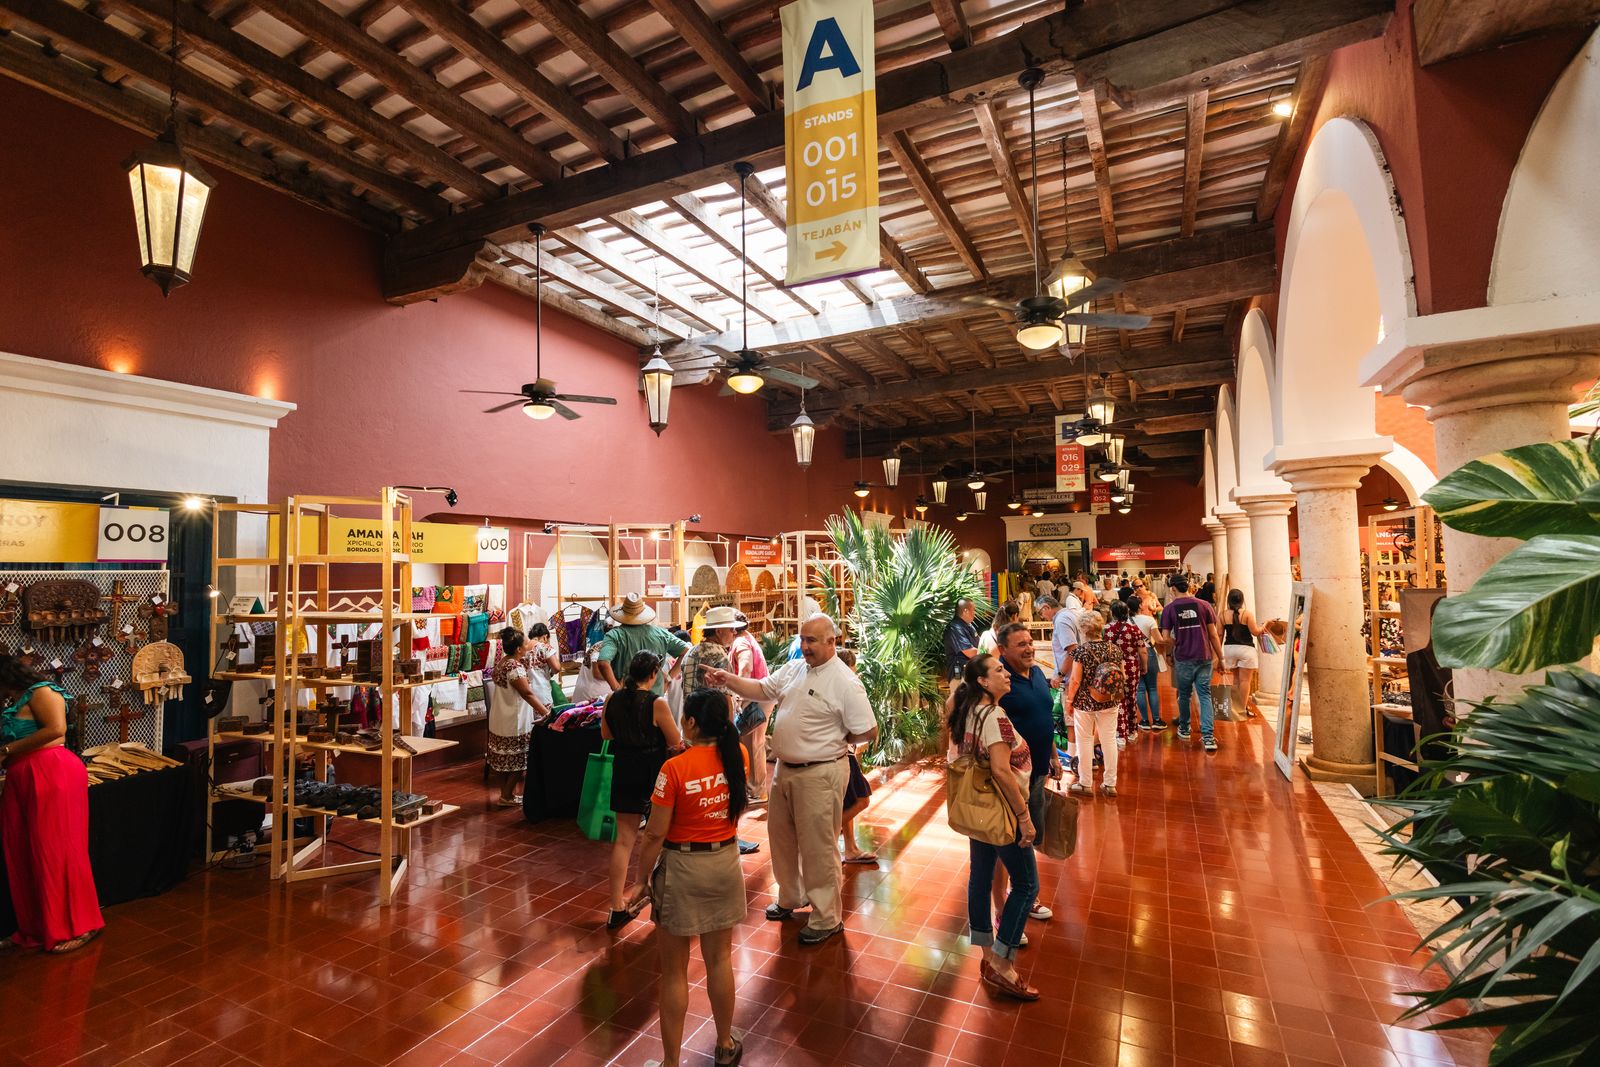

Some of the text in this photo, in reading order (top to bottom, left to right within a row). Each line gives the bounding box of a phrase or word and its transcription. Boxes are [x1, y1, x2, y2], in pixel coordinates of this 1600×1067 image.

[796, 17, 861, 92] A
[804, 108, 854, 128] STANDS
[803, 132, 857, 167] 001
[806, 173, 857, 207] 015
[802, 219, 862, 240] TEJABÁN
[1062, 453, 1079, 461] 016
[1061, 464, 1080, 472] 029
[104, 523, 165, 543] 008
[347, 529, 399, 540] AMANA
[480, 538, 508, 551] 009
[685, 773, 728, 795] STA
[700, 792, 730, 807] Reeb
